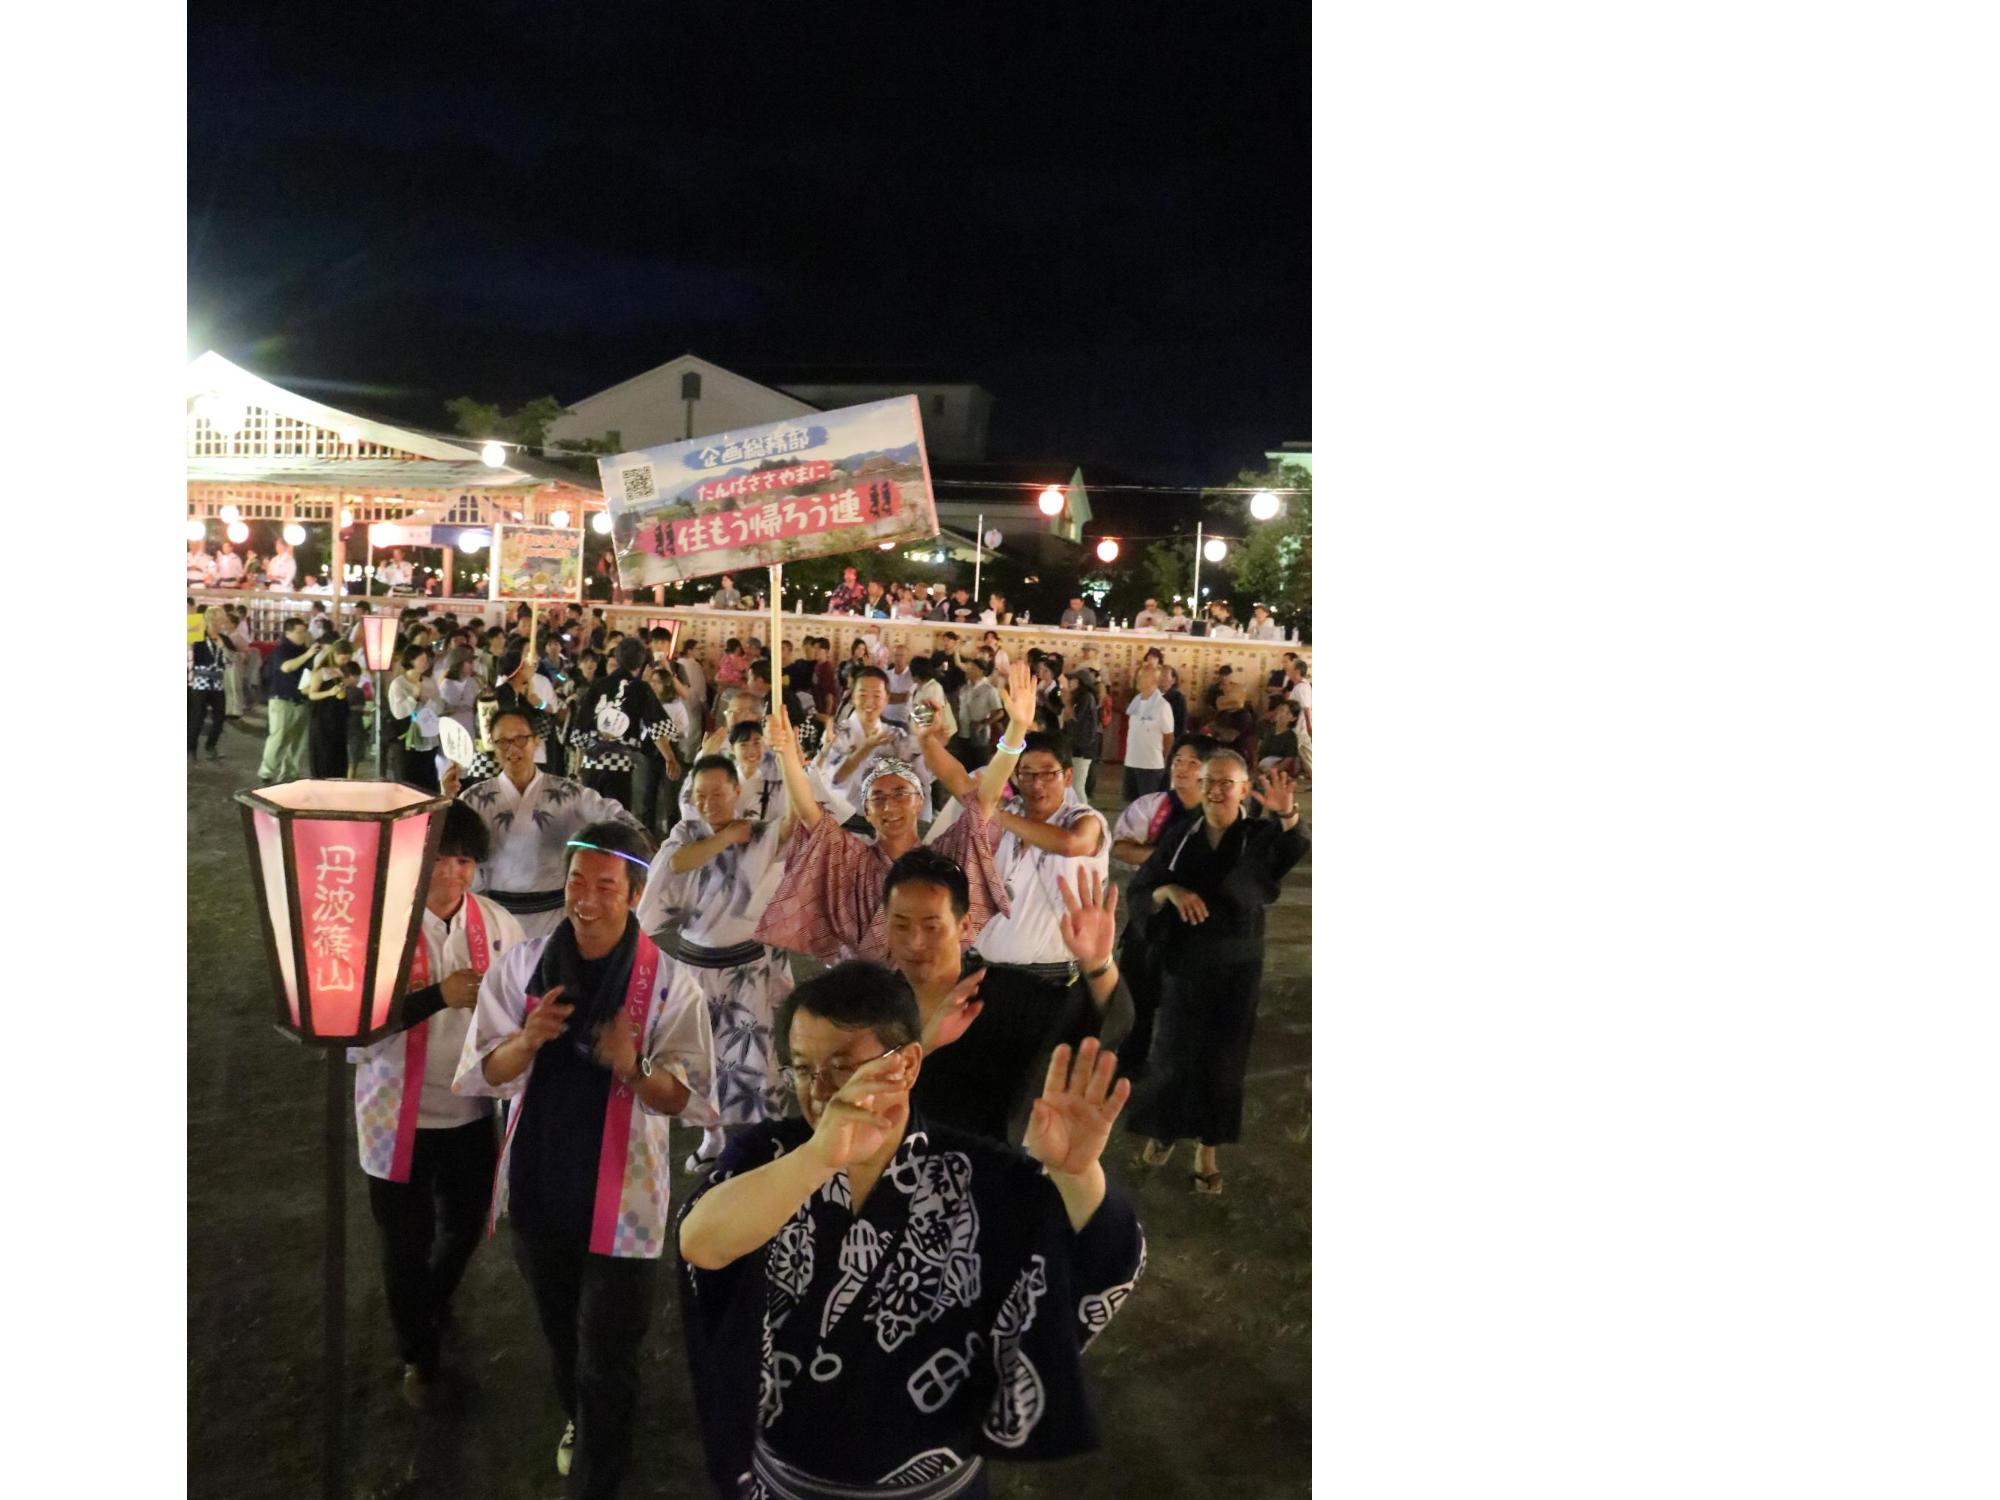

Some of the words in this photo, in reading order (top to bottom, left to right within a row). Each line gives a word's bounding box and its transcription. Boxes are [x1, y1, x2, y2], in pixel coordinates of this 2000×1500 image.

[699, 427, 810, 468] 企画総務部
[697, 464, 826, 501] たんばささやまに
[677, 488, 865, 553] 住もう帰ろう連
[312, 845, 358, 992] 丹波篠山
